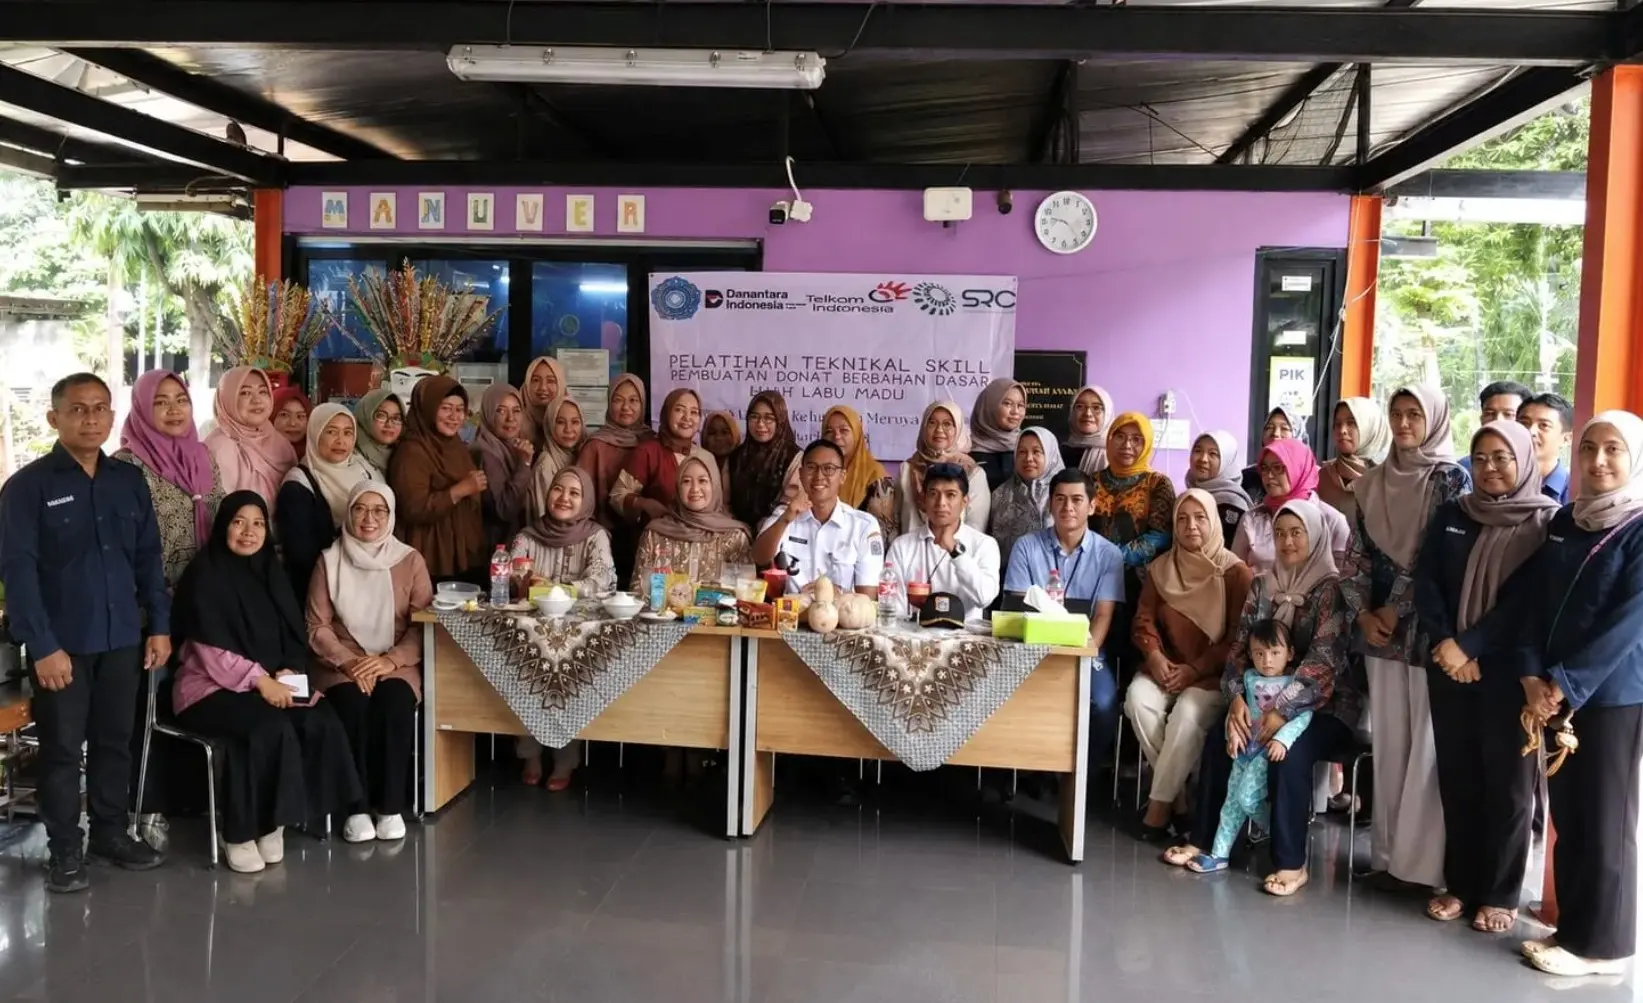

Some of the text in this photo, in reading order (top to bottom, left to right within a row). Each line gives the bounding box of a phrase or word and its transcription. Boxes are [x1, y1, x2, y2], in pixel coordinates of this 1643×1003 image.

[325, 198, 639, 226] MANUVER
[726, 289, 788, 299] Danantara
[805, 294, 864, 304] Telkom
[961, 289, 1016, 308] SRC
[726, 301, 784, 310] Indonesia
[669, 354, 990, 374] PELATIHAN TEKNIKAL SKILL
[671, 369, 989, 387] PEMBUATAN DONAT BERBAHAN DASAR
[1279, 368, 1305, 380] PIK
[802, 387, 845, 399] LABU
[854, 388, 904, 400] MADU
[866, 411, 919, 427] Meruya
